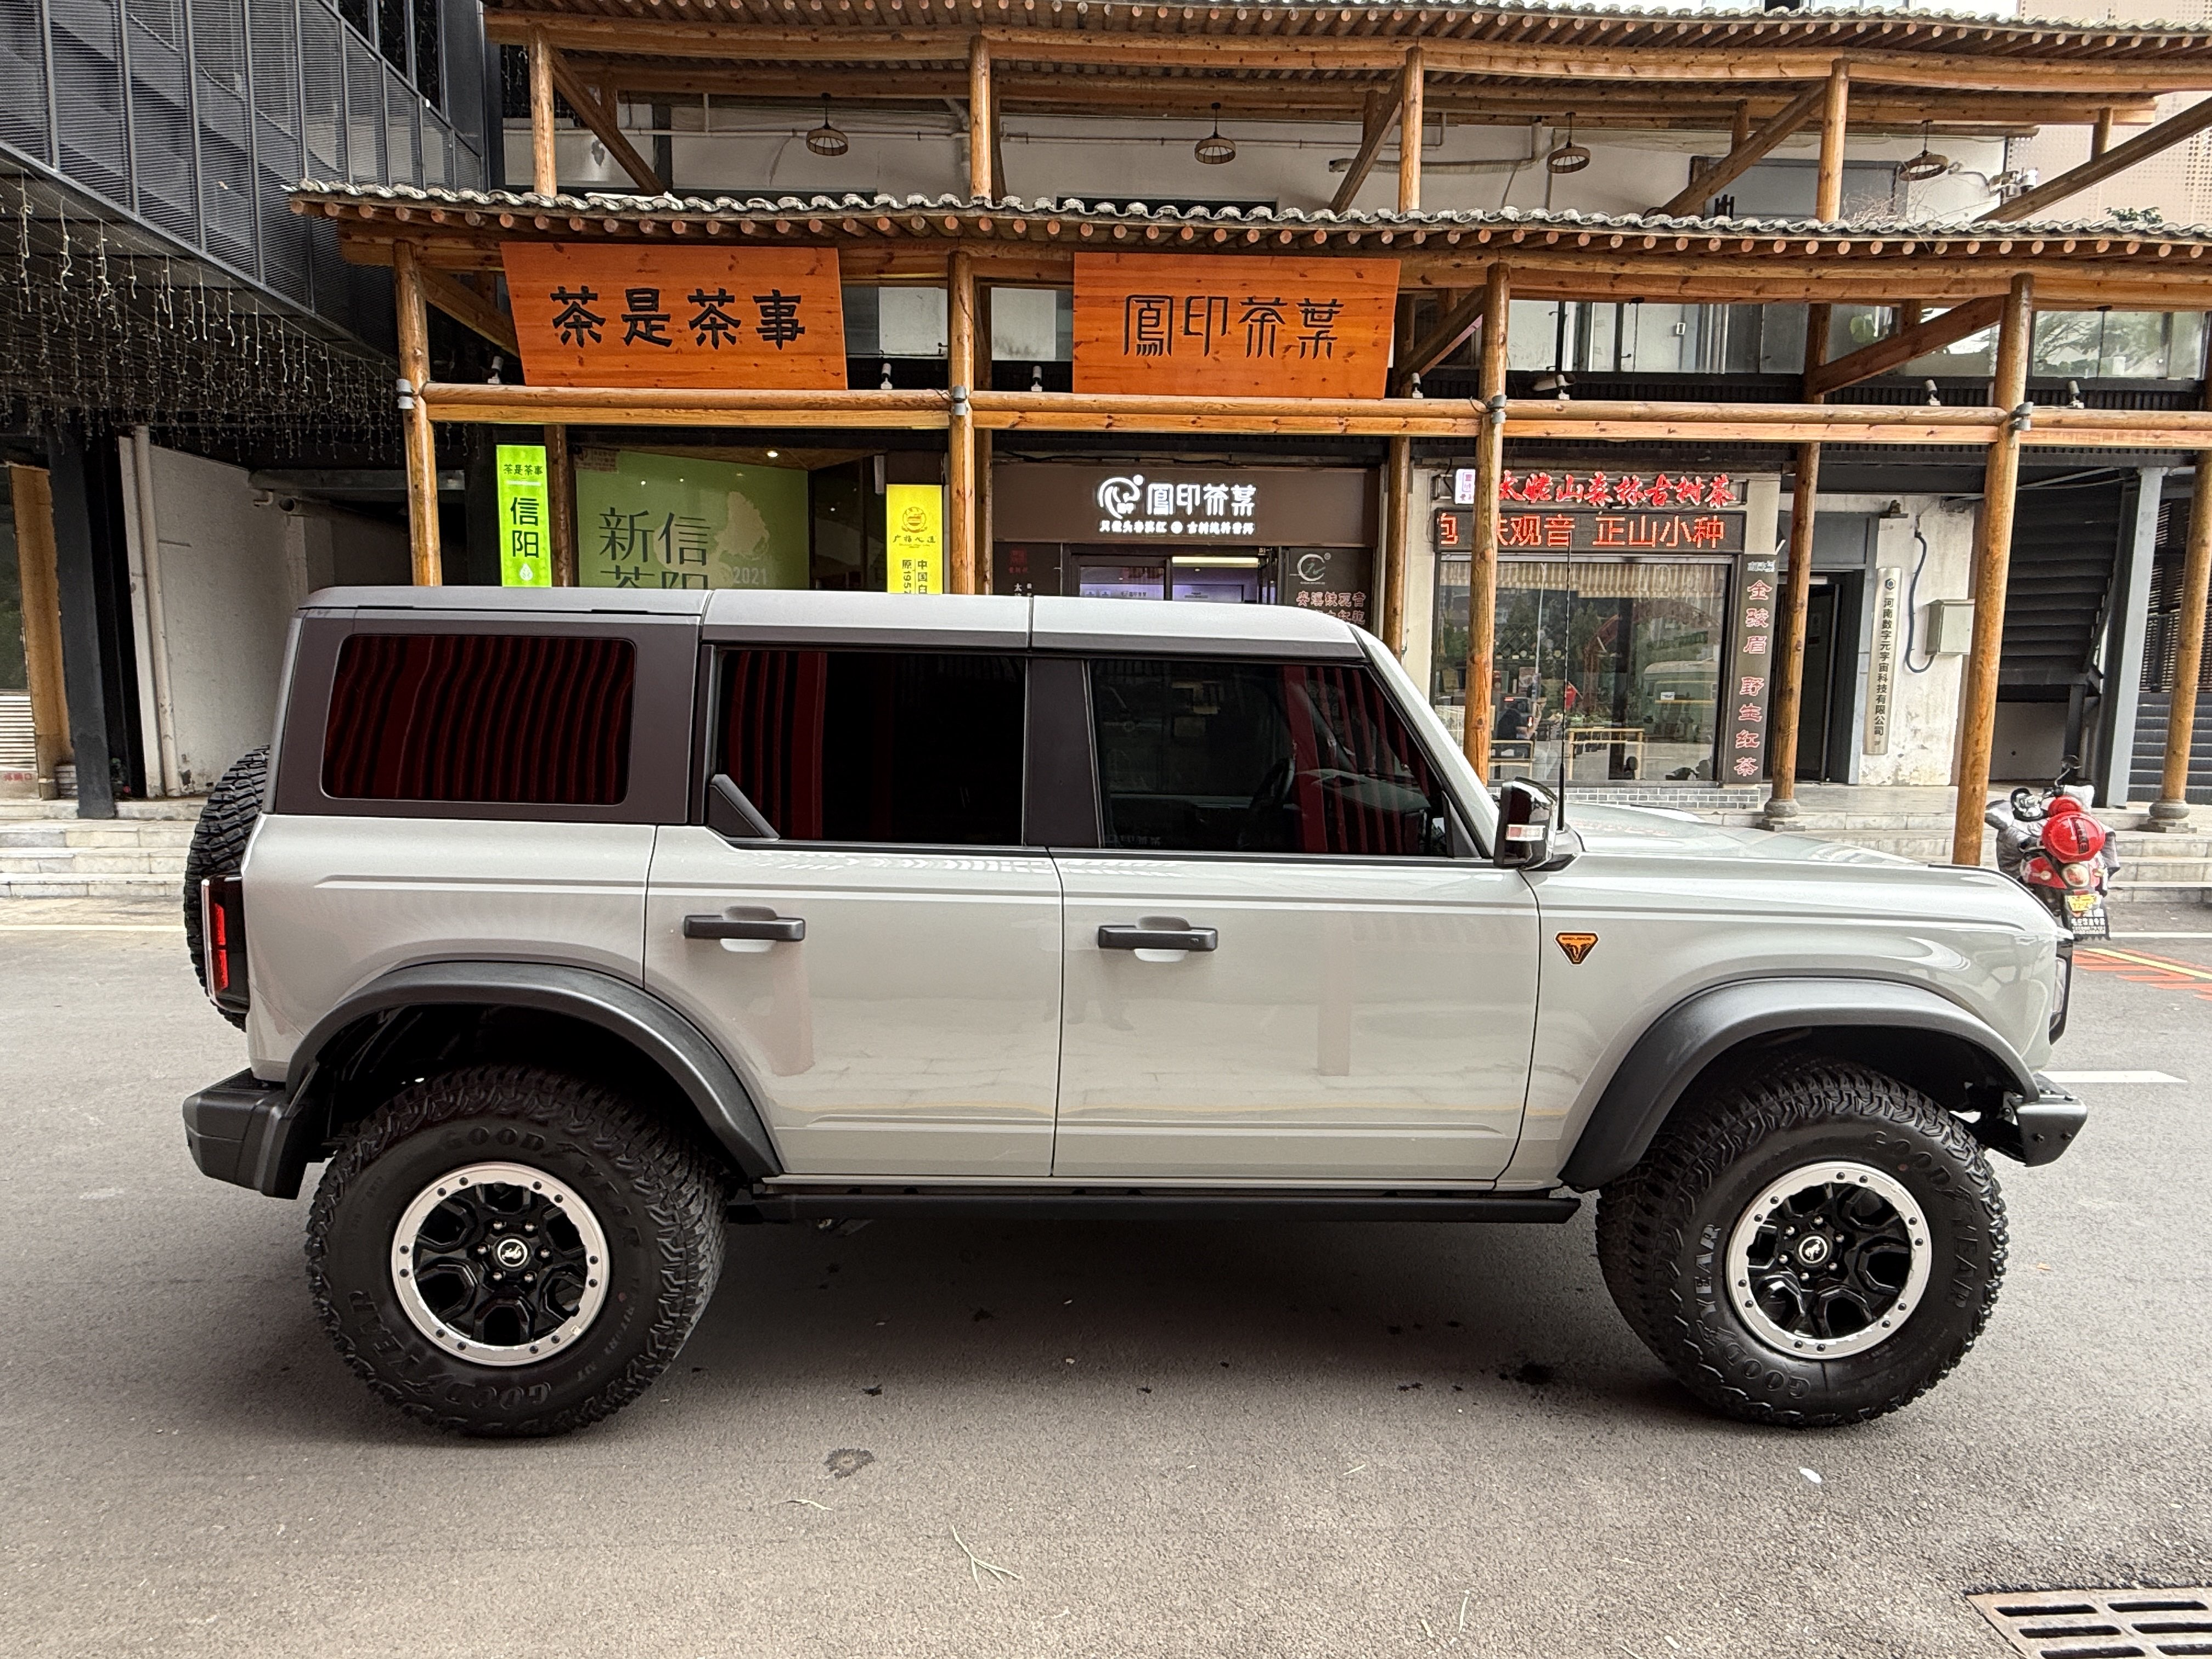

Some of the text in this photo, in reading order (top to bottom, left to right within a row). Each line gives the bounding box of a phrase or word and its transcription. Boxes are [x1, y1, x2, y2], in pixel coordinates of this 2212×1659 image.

[550, 285, 806, 351] 茶是茶事
[1123, 294, 1345, 360] 鳳印茶葉
[503, 464, 543, 476] 茶是茶事
[510, 496, 540, 558] 信阳
[1592, 515, 1725, 549] 正山小种
[732, 566, 768, 585] 2021
[1296, 590, 1367, 607] 安溪铁观音
[1743, 579, 1773, 654] 金骏眉
[1874, 597, 1894, 736] 河南数字元宇宙科技有限公司
[1734, 676, 1765, 777] 野生红茶
